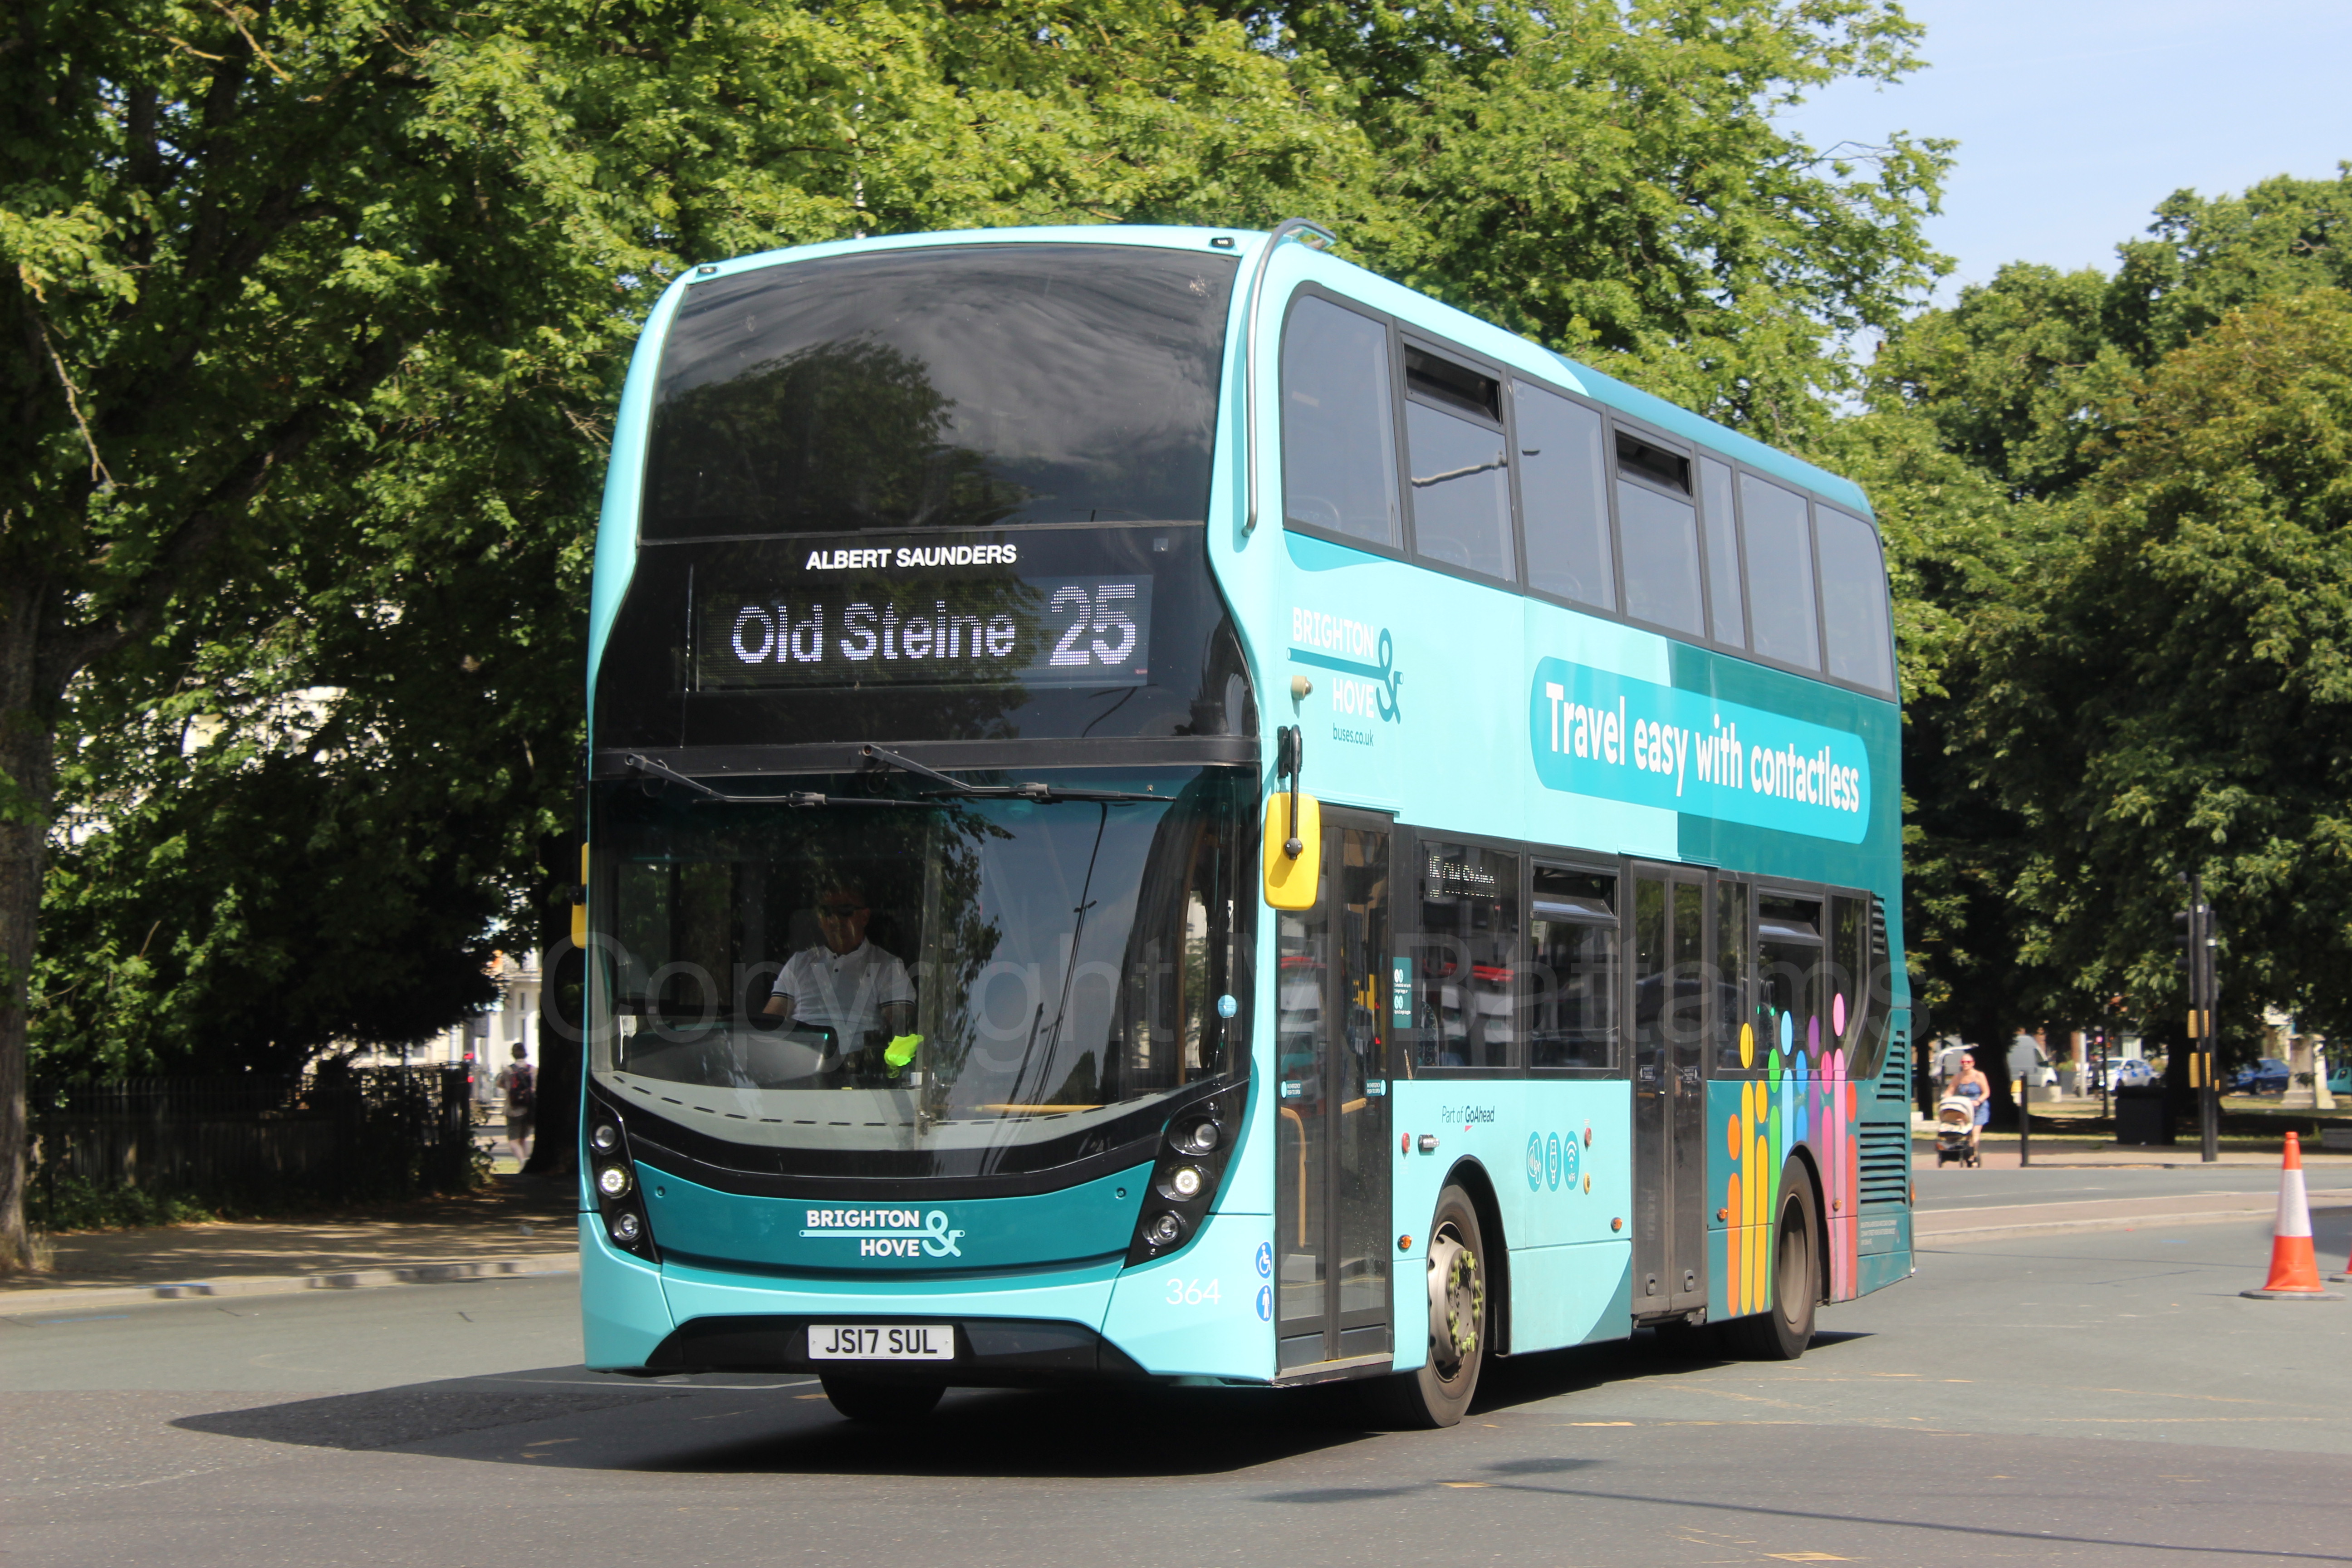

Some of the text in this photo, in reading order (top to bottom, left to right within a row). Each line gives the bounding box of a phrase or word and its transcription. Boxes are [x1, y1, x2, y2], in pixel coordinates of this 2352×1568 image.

[806, 544, 1017, 570] ALBERT SAUNDERS
[732, 601, 1015, 663] Old Steine
[1049, 584, 1137, 666] 25
[1293, 607, 1374, 659] BRIGHTON
[1333, 677, 1374, 718] HOVE
[1333, 723, 1374, 746] buses.co.uk
[1546, 682, 1859, 812] Travel easy with contactless
[1442, 1105, 1495, 1123] Part of GoAhead
[807, 1210, 920, 1227] BRIGHTON
[861, 1239, 920, 1256] HOVE
[1166, 1278, 1222, 1305] 364
[826, 1329, 937, 1353] JS17 SUL
